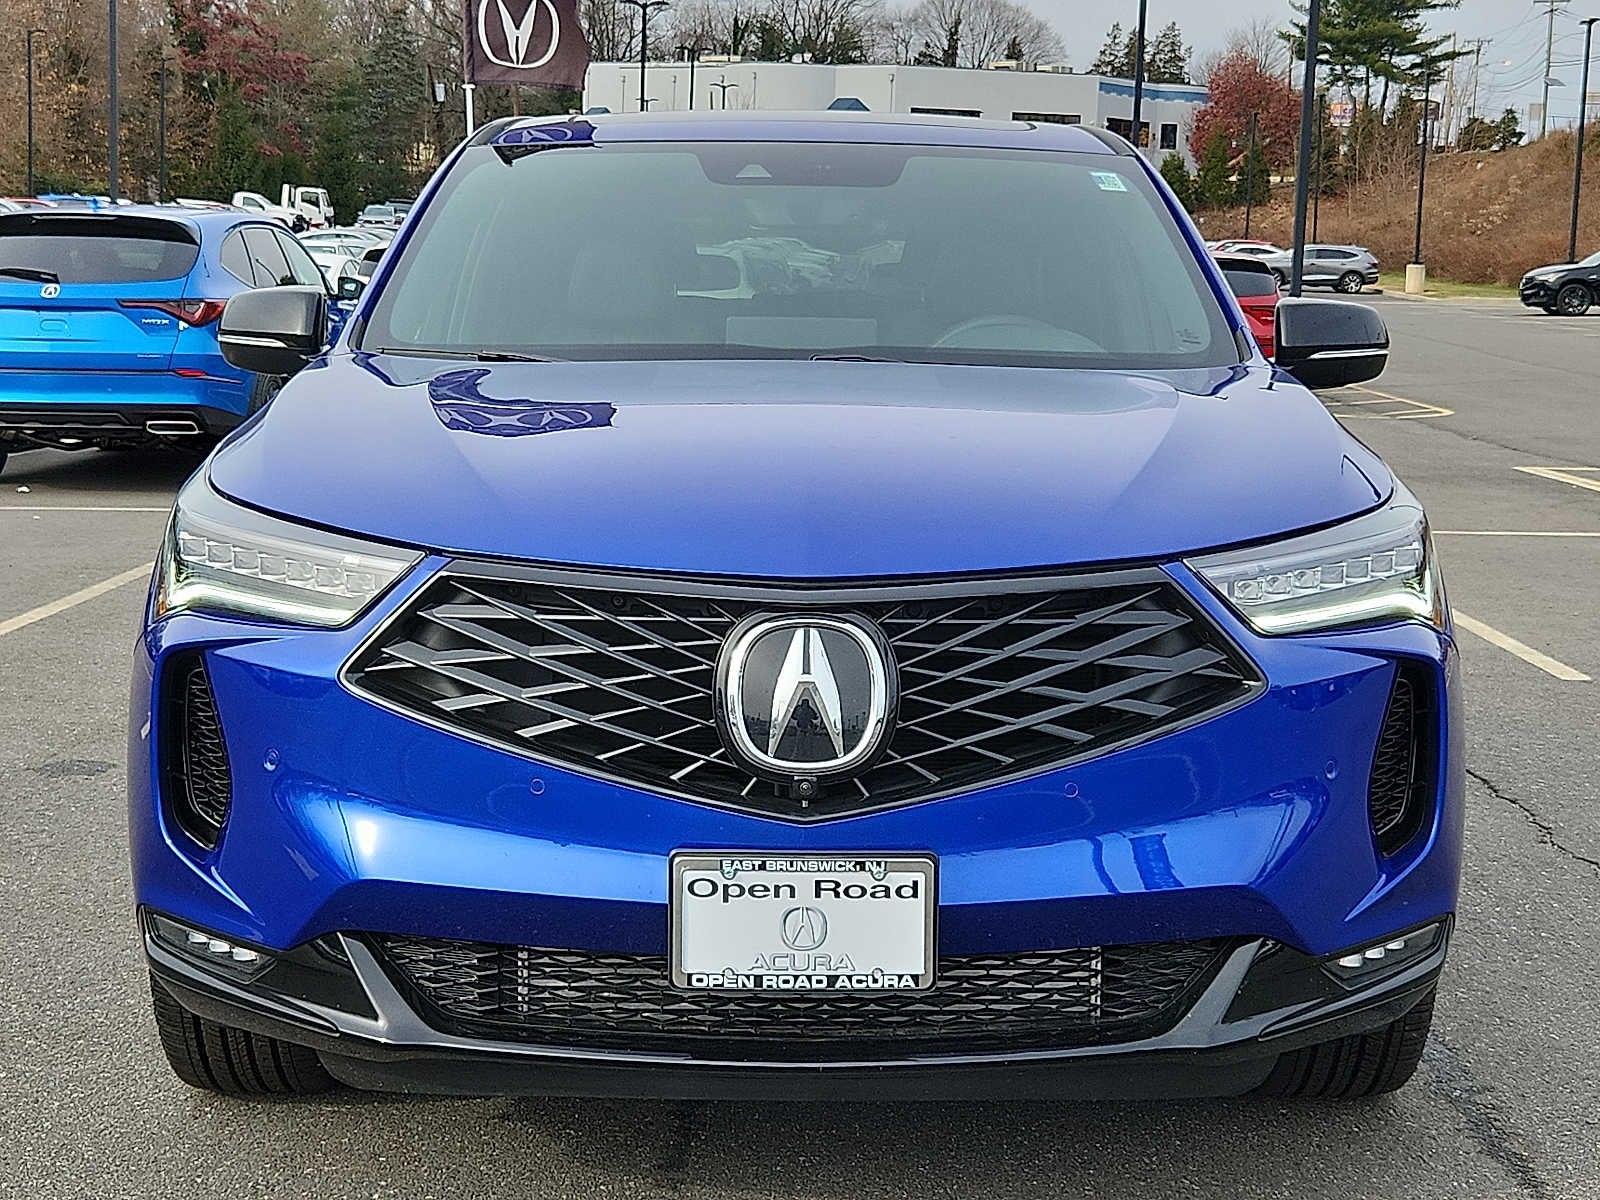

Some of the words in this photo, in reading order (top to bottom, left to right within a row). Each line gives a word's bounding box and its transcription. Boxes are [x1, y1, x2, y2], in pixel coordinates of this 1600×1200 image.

[722, 860, 763, 871] EAST
[765, 860, 860, 872] BRUNSWICK,
[865, 860, 886, 872] NJ
[687, 878, 796, 903] Open
[814, 879, 919, 899] Road
[750, 953, 856, 971] ACURA
[691, 974, 755, 988] OPEN
[762, 974, 828, 988] ROAD
[834, 974, 916, 988] ACURA
